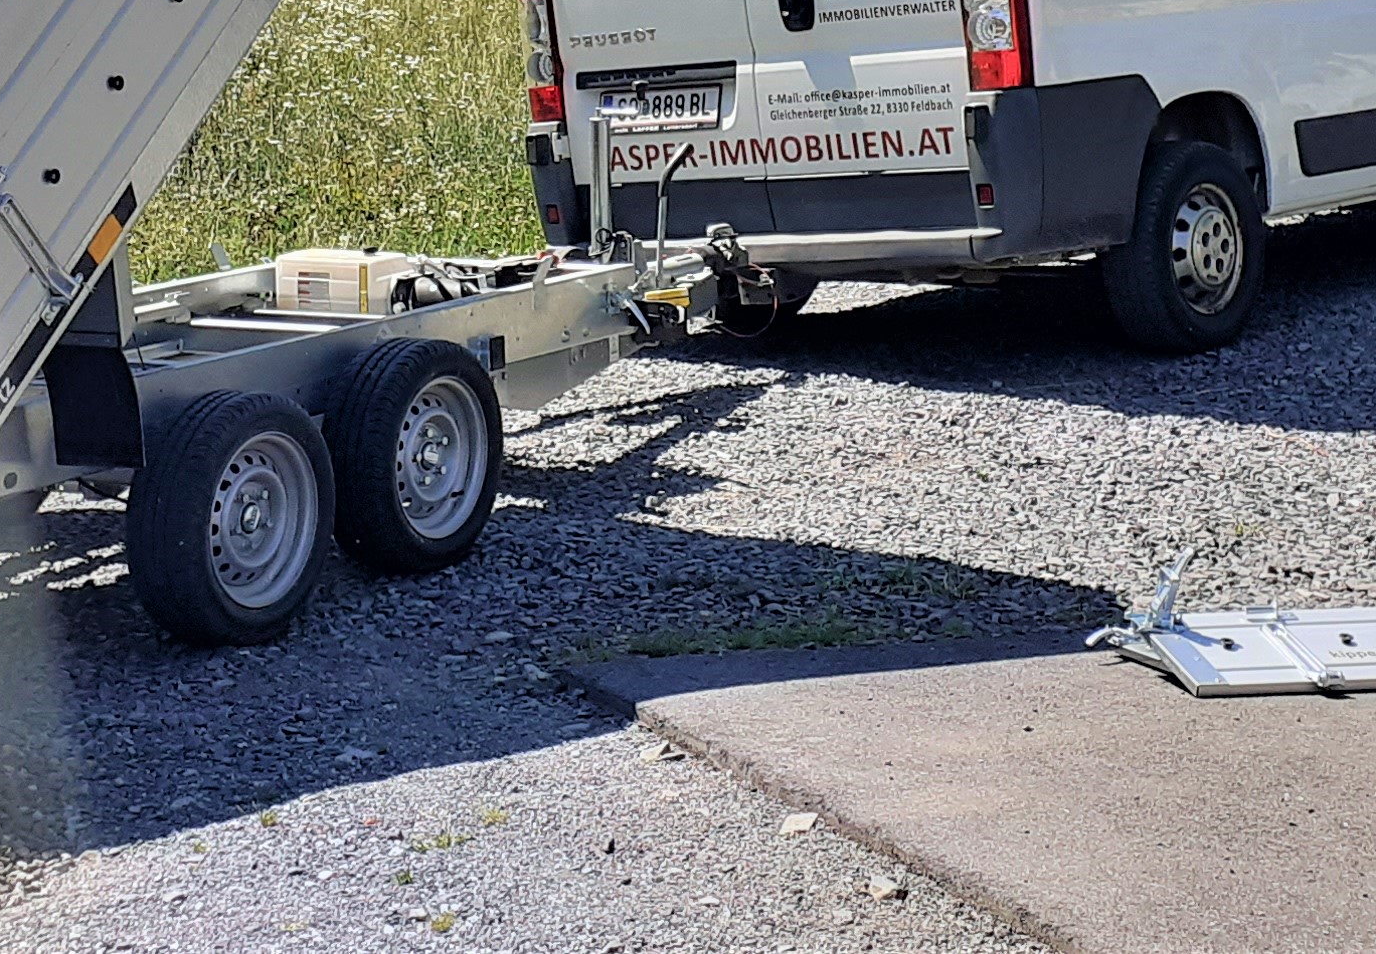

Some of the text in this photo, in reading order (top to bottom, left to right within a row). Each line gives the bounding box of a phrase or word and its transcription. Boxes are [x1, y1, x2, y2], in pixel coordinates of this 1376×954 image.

[818, 0, 956, 23] IMMOBILIENVERWALTER
[569, 27, 656, 48] PEUGEOT
[768, 83, 951, 105] E-Mail: office@kasper-immobilien.at
[770, 106, 837, 121] Gleichenberger
[839, 104, 868, 117] Straße
[886, 101, 909, 113] 8330
[911, 97, 953, 111] Feldbach
[610, 126, 954, 172] ASPER-IMMOBILIEN.AT
